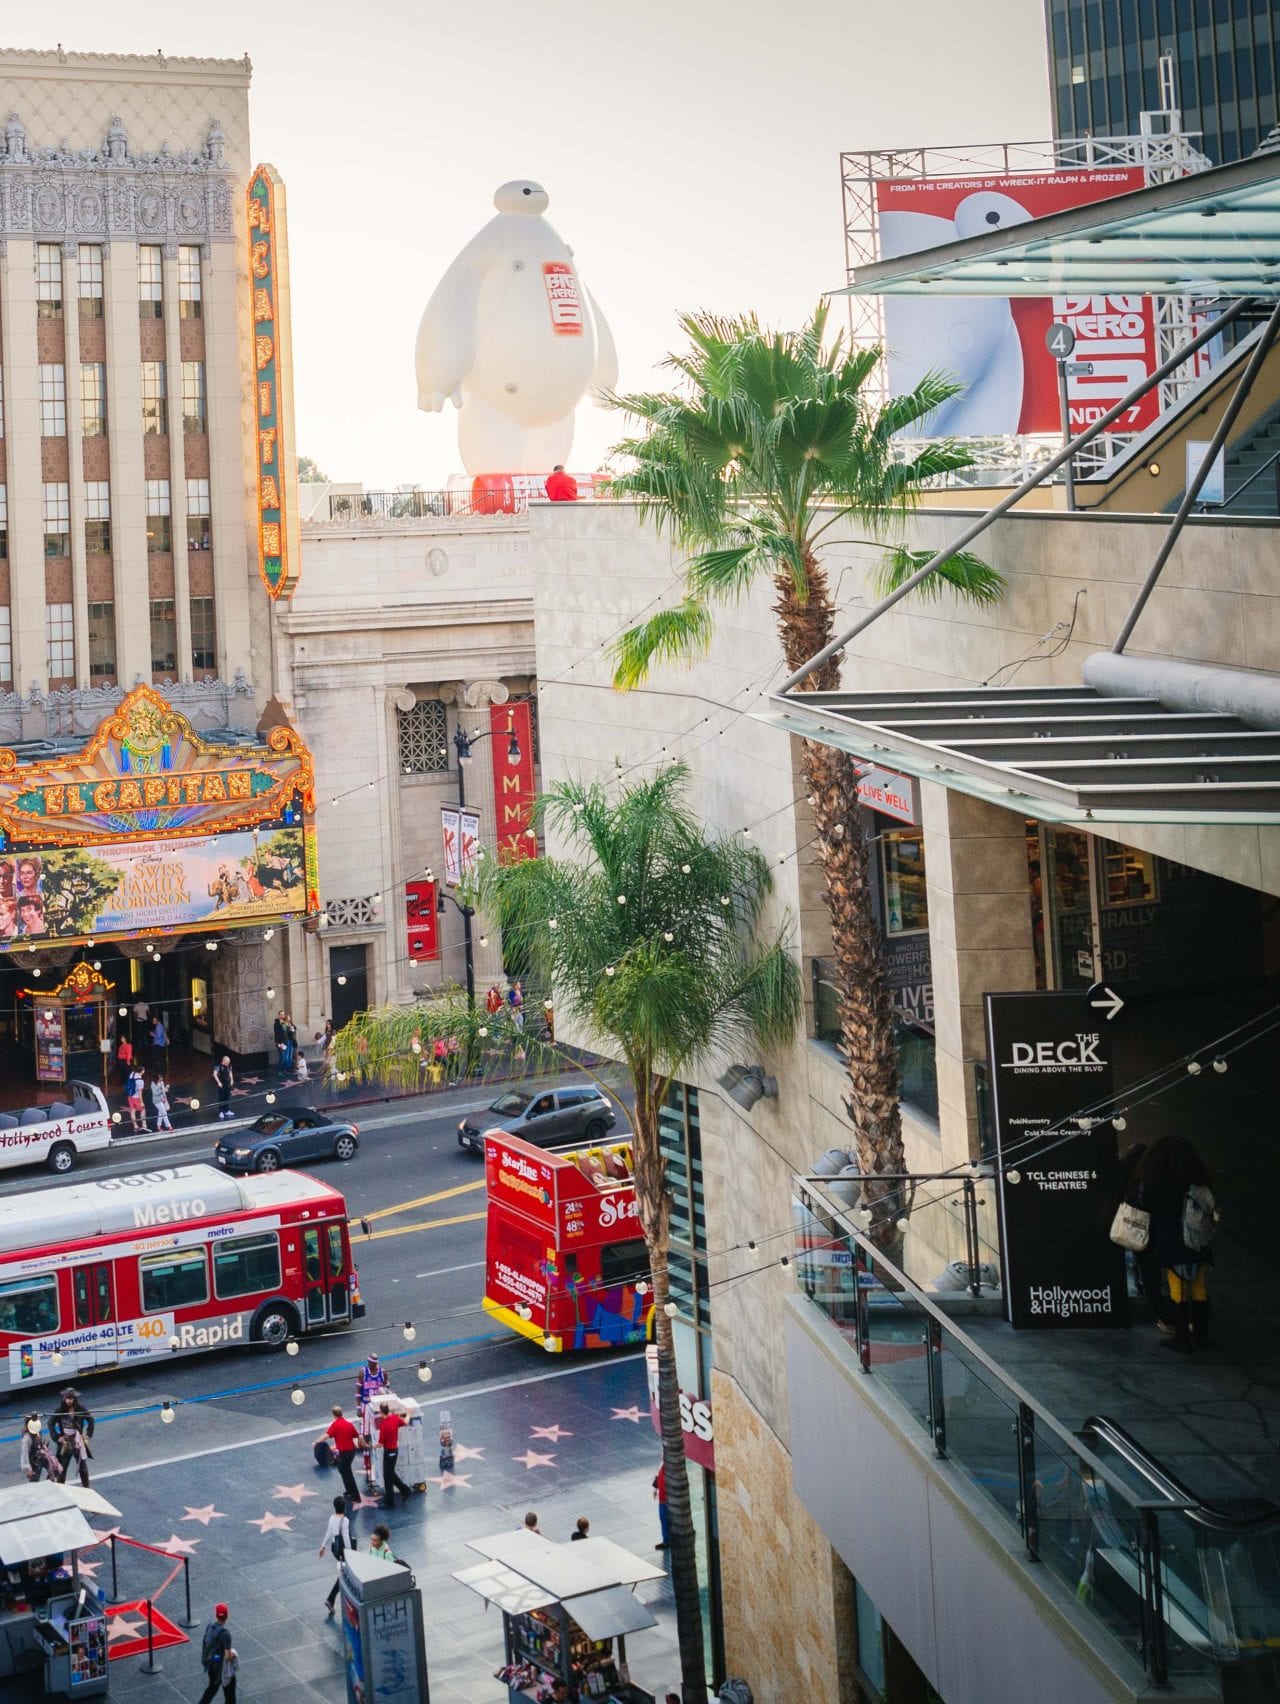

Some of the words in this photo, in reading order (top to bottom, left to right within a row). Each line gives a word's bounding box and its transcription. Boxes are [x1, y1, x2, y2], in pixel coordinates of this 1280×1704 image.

[936, 181, 982, 190] CREATORS
[999, 176, 1045, 187] WRECK-IT
[1047, 175, 1078, 184] RALPH
[1089, 173, 1128, 182] FROZEN
[545, 273, 577, 289] BIG
[548, 288, 578, 298] HERO
[551, 298, 583, 324] 6
[1051, 329, 1066, 353] 4
[252, 240, 280, 557] CAPITAN
[1126, 405, 1141, 423] 7
[45, 785, 86, 814] EL
[94, 772, 251, 811] CAPITAN
[862, 783, 883, 801] LIVE
[885, 791, 910, 813] WELL
[96, 844, 155, 856] THROWBACK
[160, 839, 209, 852] THURSDAY
[133, 863, 183, 879] SWISS
[120, 876, 187, 896] FAMILY
[106, 891, 191, 912] ROBINSON
[1075, 1033, 1099, 1043] THE
[1012, 1041, 1101, 1064] DECK
[1014, 1066, 1040, 1074] DINING
[67, 1119, 104, 1135] Tours
[1027, 1172, 1047, 1181] TCL
[1048, 1171, 1090, 1180] CHINESE
[1091, 1170, 1097, 1179] 6
[1038, 1181, 1088, 1190] THEATRES
[133, 1199, 206, 1227] Metro
[1030, 1285, 1111, 1304] Hollywood
[1030, 1299, 1112, 1318] &Highland
[39, 1331, 98, 1351] Nationwide
[99, 1327, 114, 1338] 4G
[116, 1324, 134, 1336] LTE
[181, 1315, 243, 1348] Rapid
